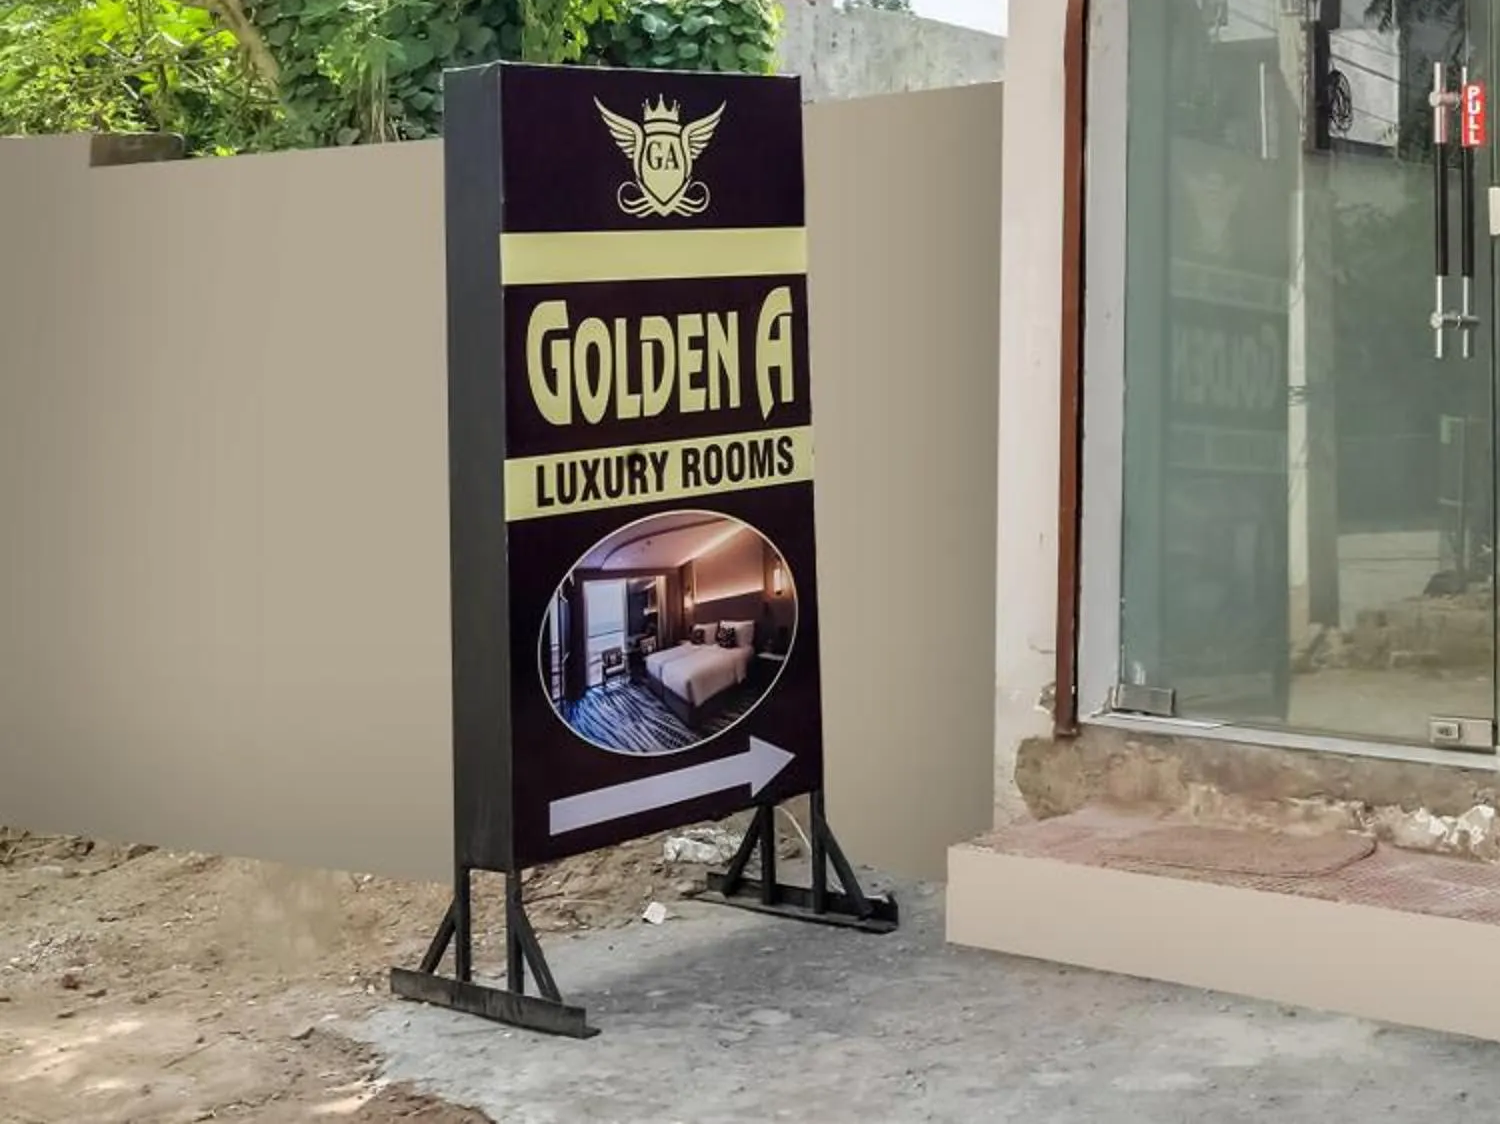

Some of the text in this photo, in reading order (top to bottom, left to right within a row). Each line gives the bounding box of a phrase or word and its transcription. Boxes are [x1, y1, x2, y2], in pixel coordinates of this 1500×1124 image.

[1467, 84, 1481, 145] PULL
[646, 140, 679, 171] GA
[526, 285, 795, 426] GOLDEN A
[535, 435, 795, 509] LUXURY ROOMS
